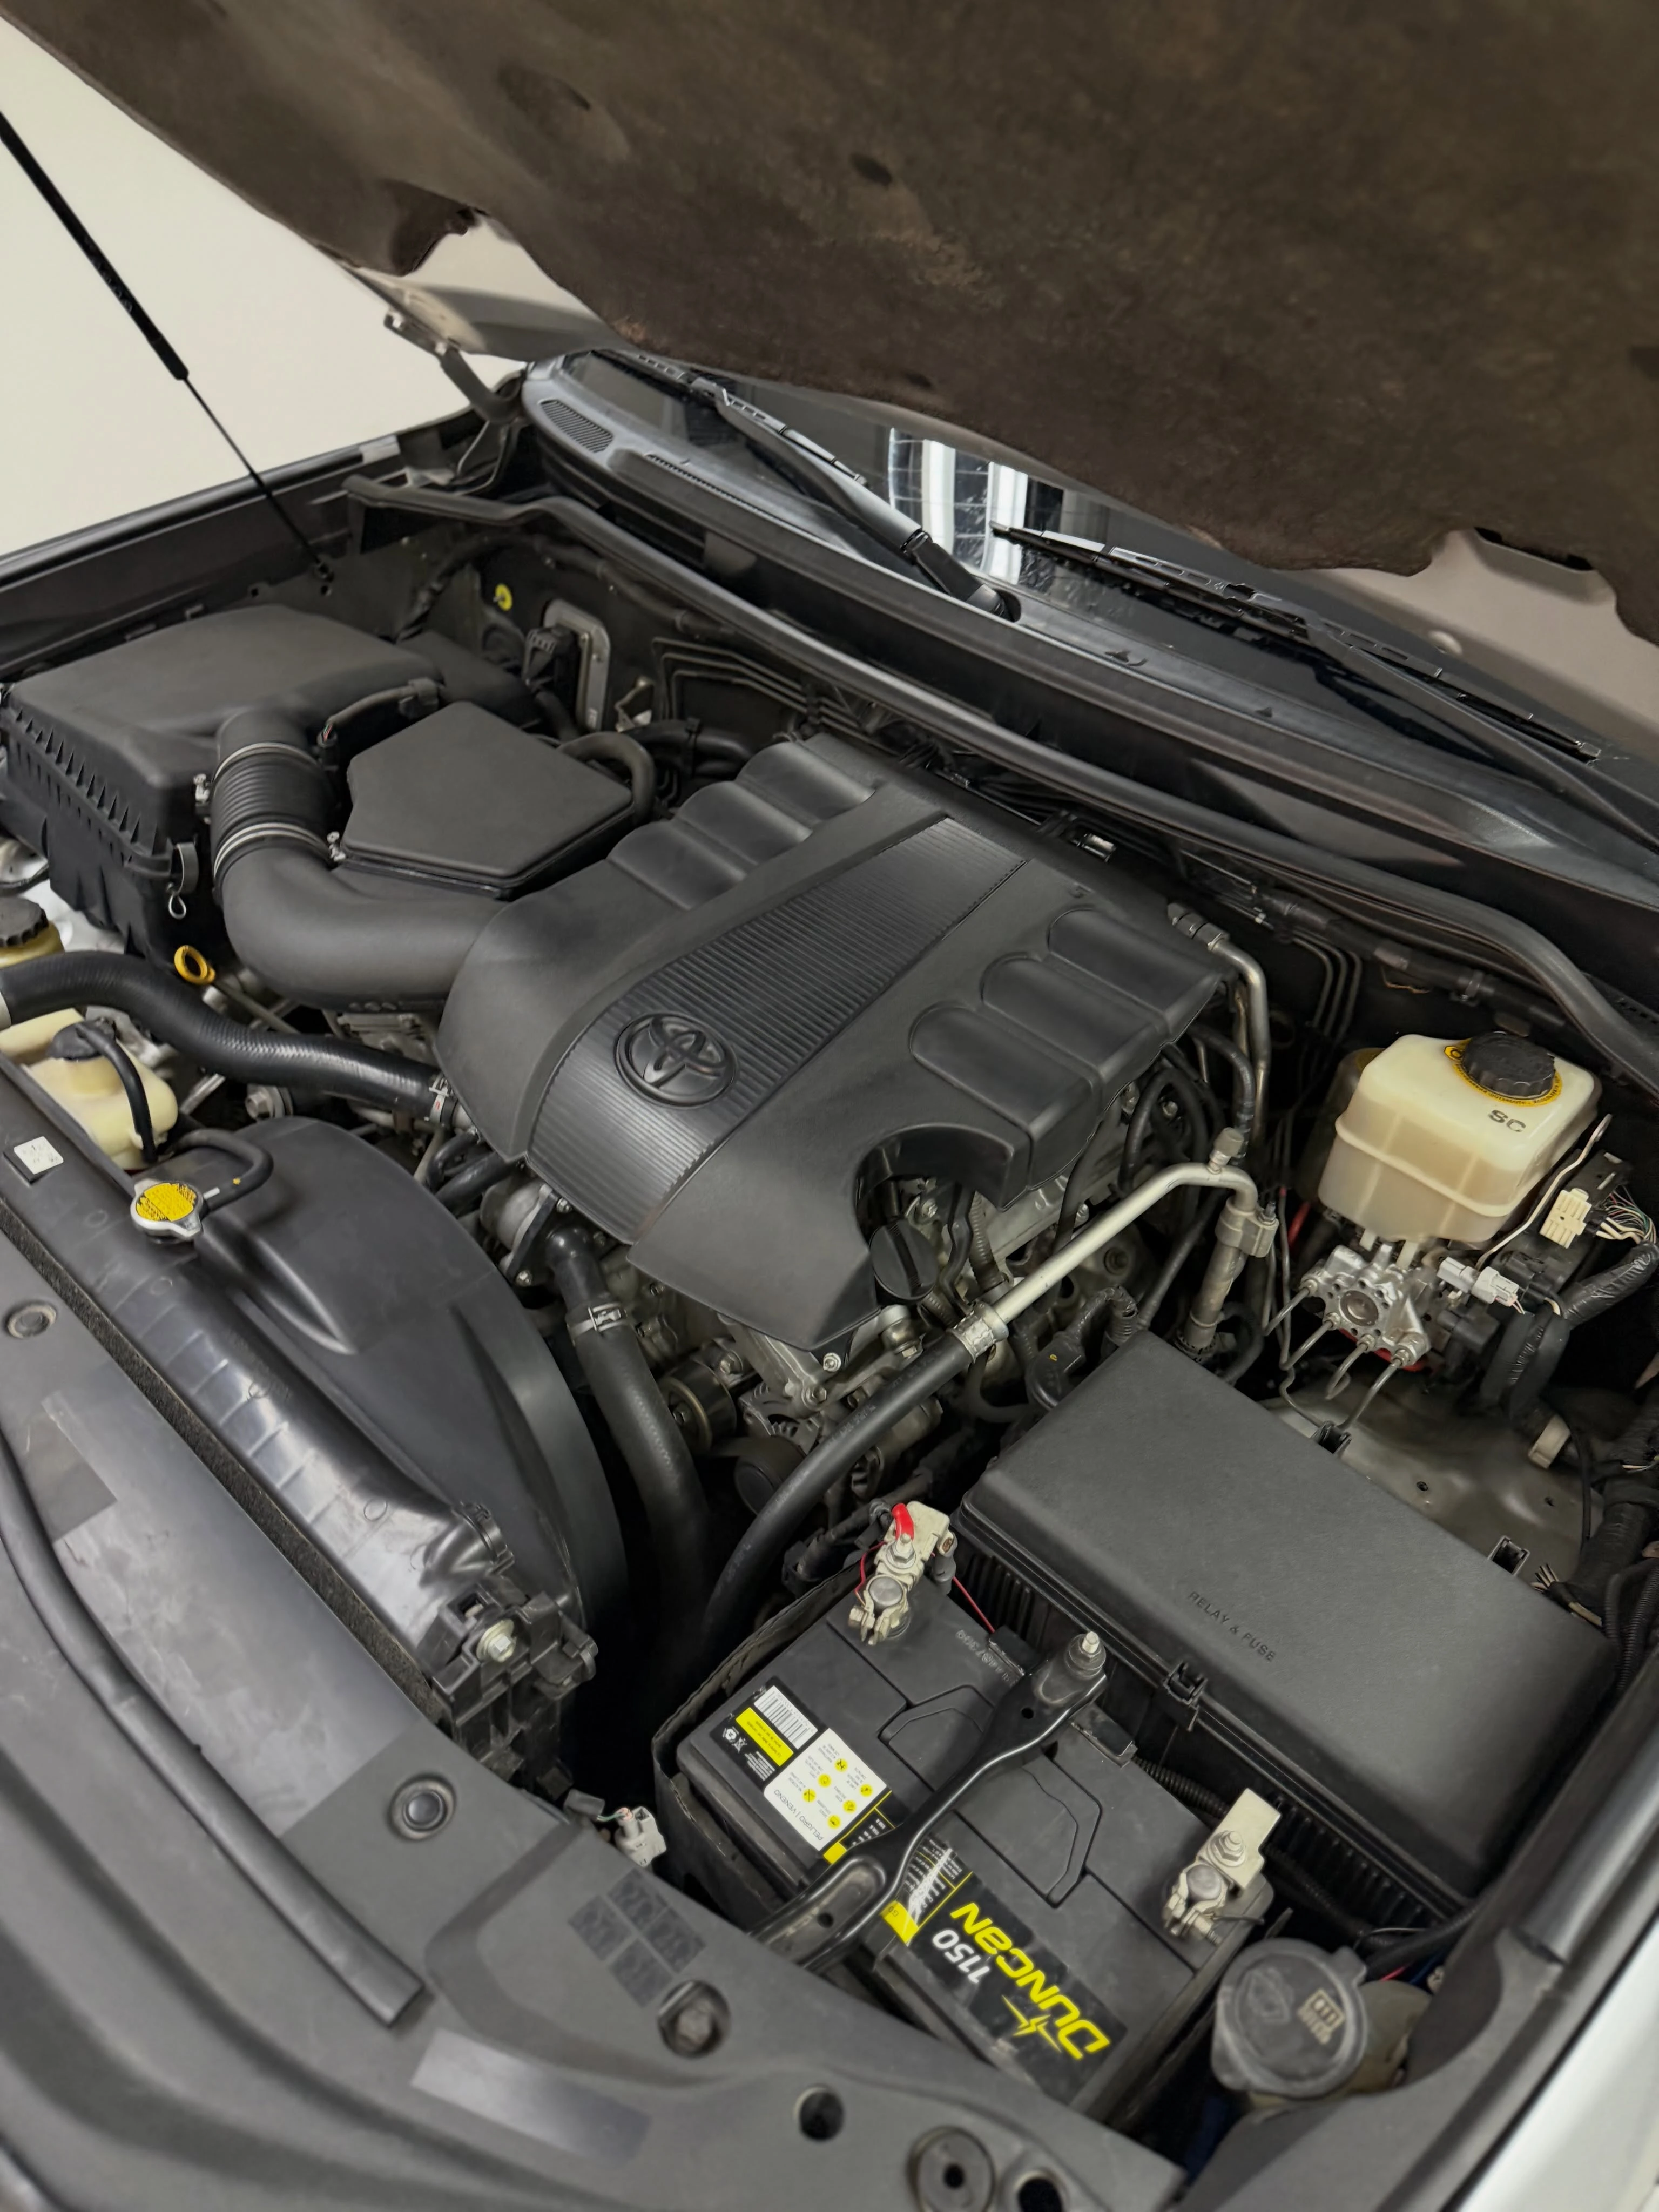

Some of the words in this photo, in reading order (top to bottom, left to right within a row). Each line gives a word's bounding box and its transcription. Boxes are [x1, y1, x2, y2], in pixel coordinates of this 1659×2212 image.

[1488, 1110, 1526, 1132] SC
[1189, 1591, 1229, 1624] RELAY
[1230, 1625, 1240, 1635] &
[1242, 1632, 1276, 1662] FUSE
[773, 1788, 798, 1813] VENENO
[798, 1815, 825, 1841] PELIGRO
[932, 1928, 990, 1984] 1150
